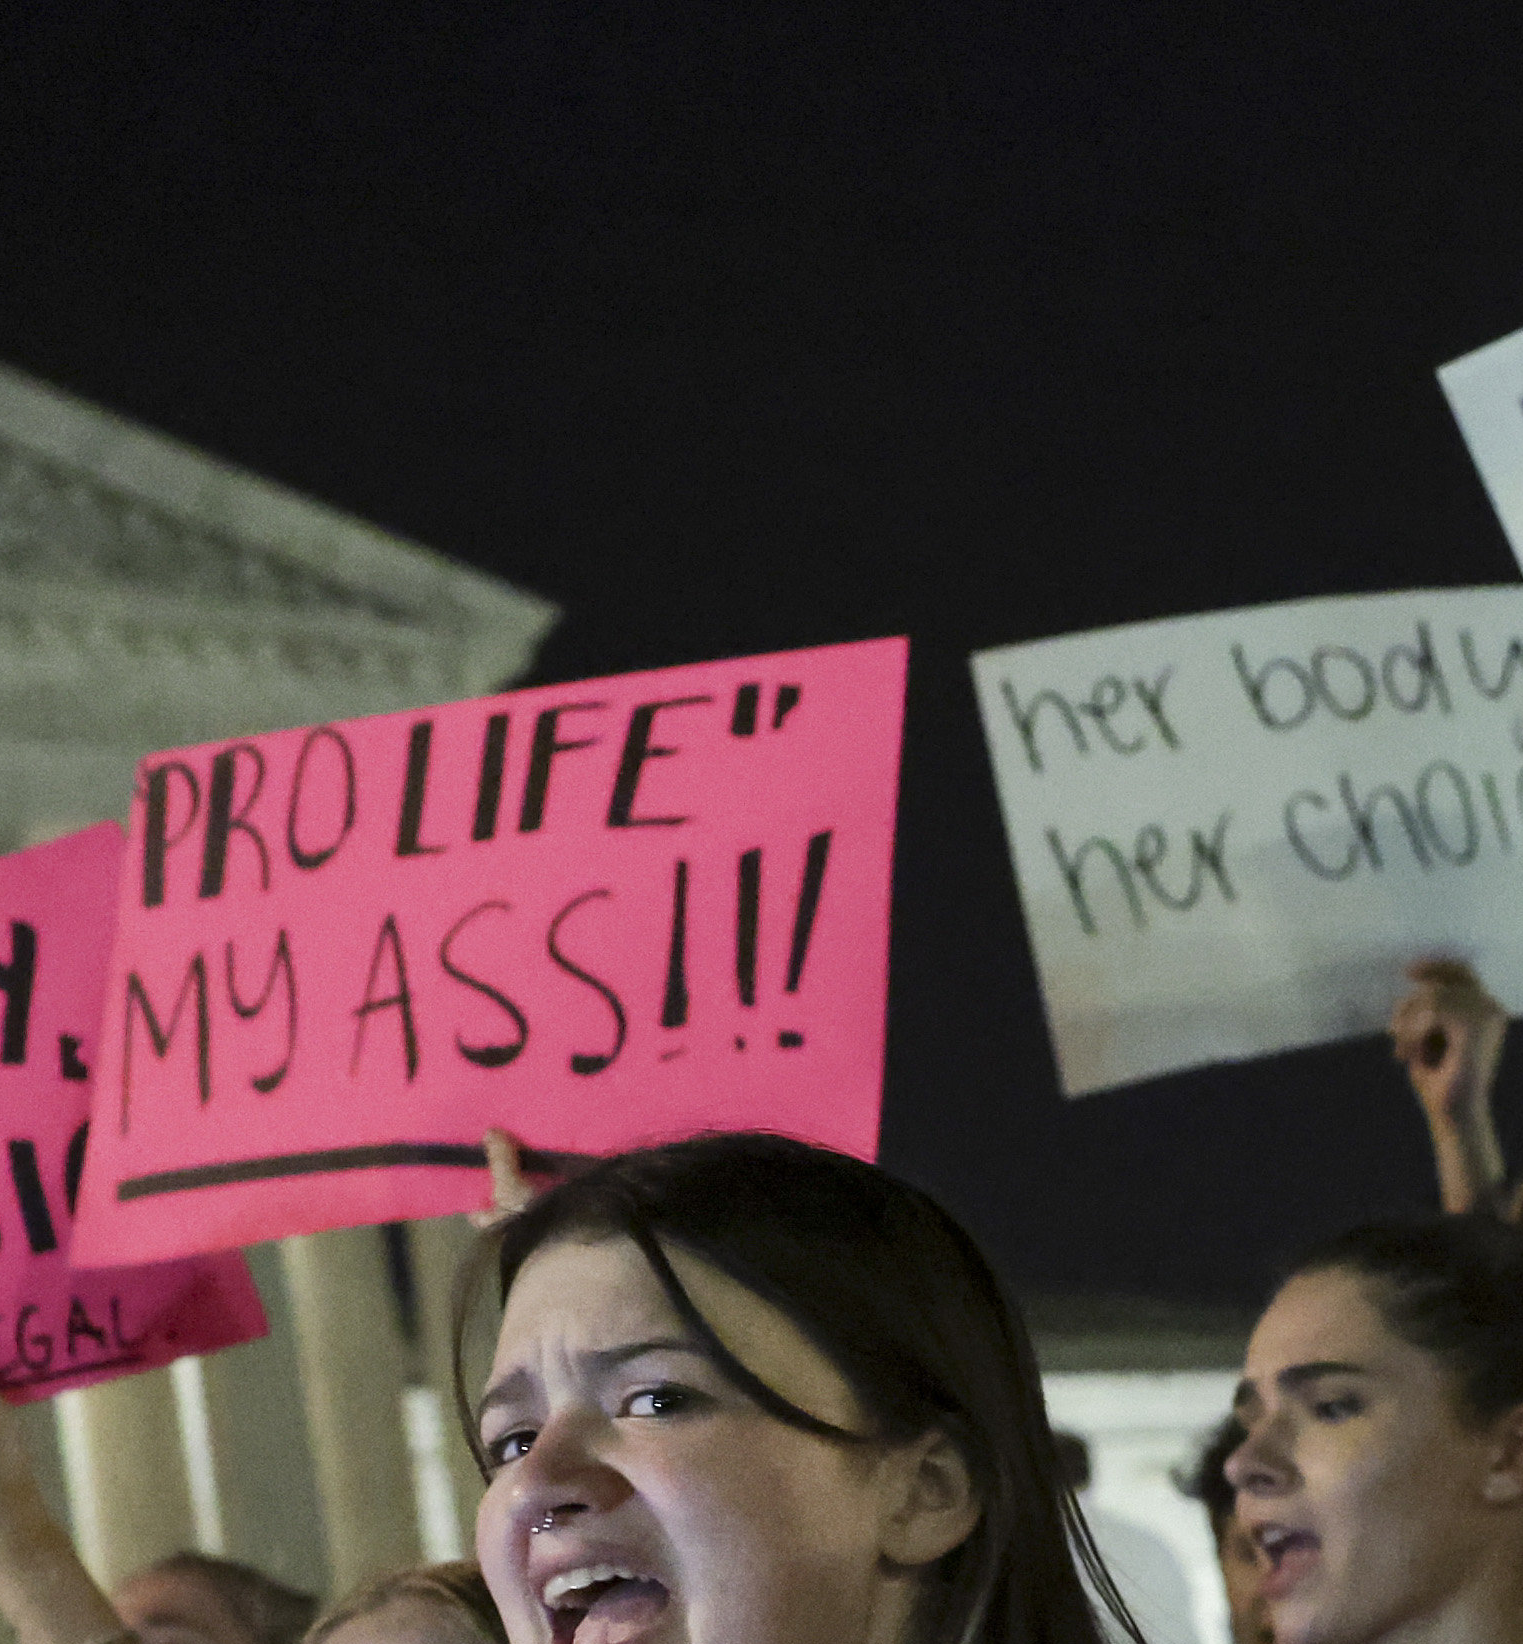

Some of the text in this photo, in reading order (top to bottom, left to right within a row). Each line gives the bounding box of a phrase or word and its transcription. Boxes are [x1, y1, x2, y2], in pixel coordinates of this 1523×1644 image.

[395, 682, 801, 858] LIFE"
[1000, 662, 1181, 773] her
[1045, 807, 1238, 936] her
[121, 828, 835, 1137] MY ASS!!!
